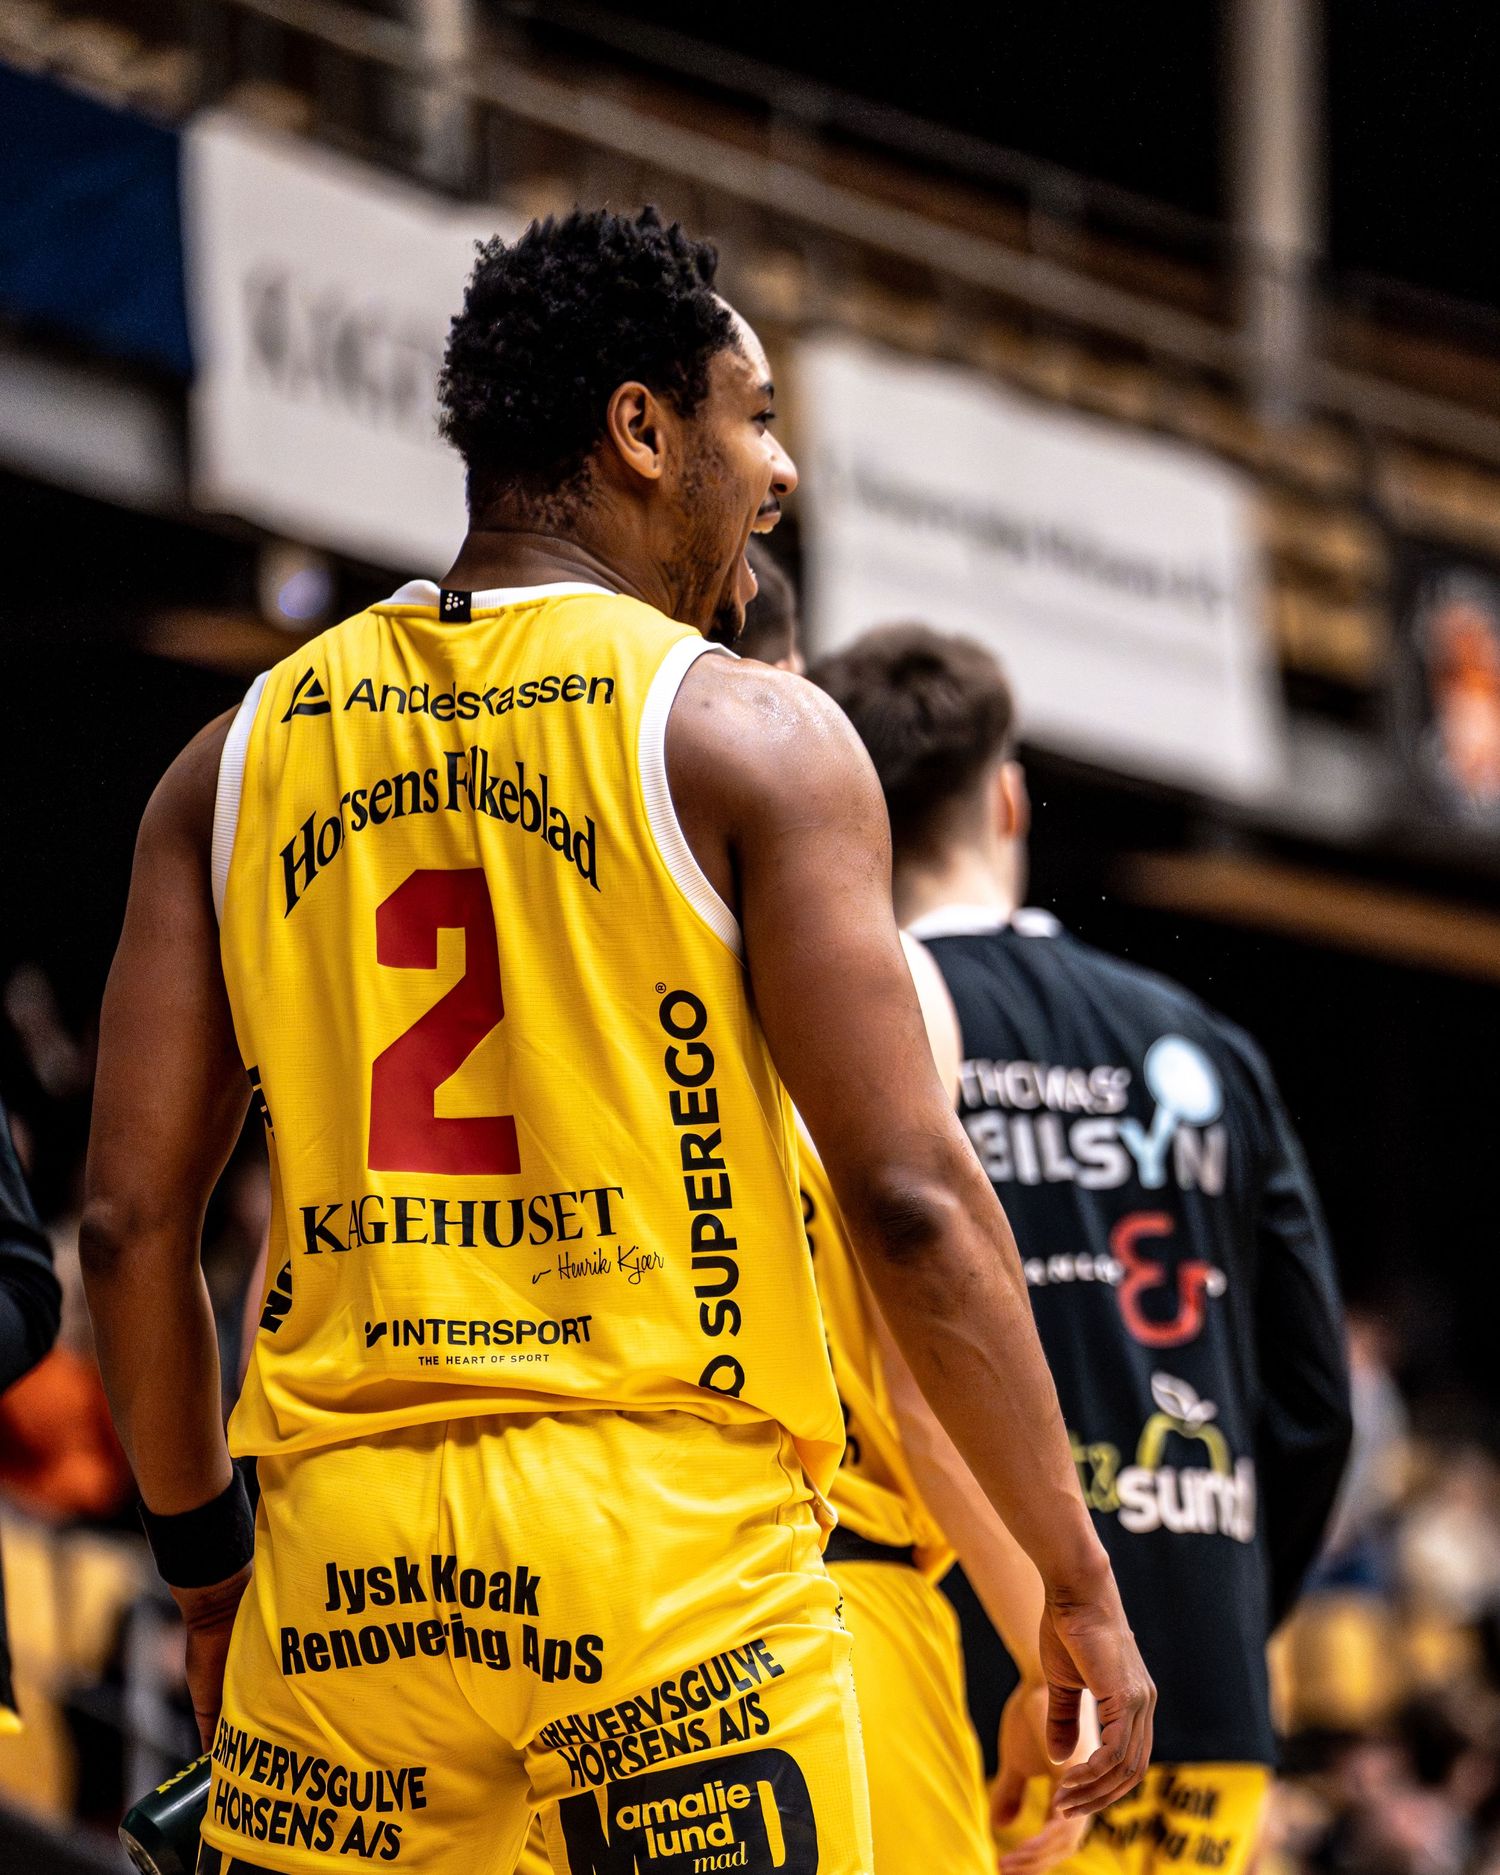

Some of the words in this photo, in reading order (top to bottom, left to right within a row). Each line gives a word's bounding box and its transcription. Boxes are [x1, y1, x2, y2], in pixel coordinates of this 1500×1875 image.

[279, 766, 438, 919] Horsens
[366, 867, 522, 1175] 2
[658, 989, 742, 1337] SUPEREGO
[963, 1109, 1228, 1196] EILSYN
[299, 1187, 624, 1255] KAGEHUSET
[557, 1247, 612, 1280] Henrik
[617, 1245, 664, 1284] Kjær
[392, 1315, 593, 1347] INTERSPORT
[418, 1356, 439, 1366] THE
[446, 1355, 485, 1365] HEART
[490, 1355, 505, 1363] OF
[510, 1353, 550, 1363] SPORT
[325, 1556, 427, 1615] Jysk
[431, 1554, 541, 1617] Koak
[280, 1612, 511, 1676] Renoveing
[522, 1623, 604, 1684] ApS
[557, 1717, 713, 1788] HORSENS
[719, 1691, 770, 1746] A/S
[214, 1778, 338, 1852] HORSENS
[340, 1815, 403, 1861] A/S
[615, 1779, 751, 1831] amalie
[644, 1813, 735, 1859] lund
[692, 1841, 749, 1874] mad
